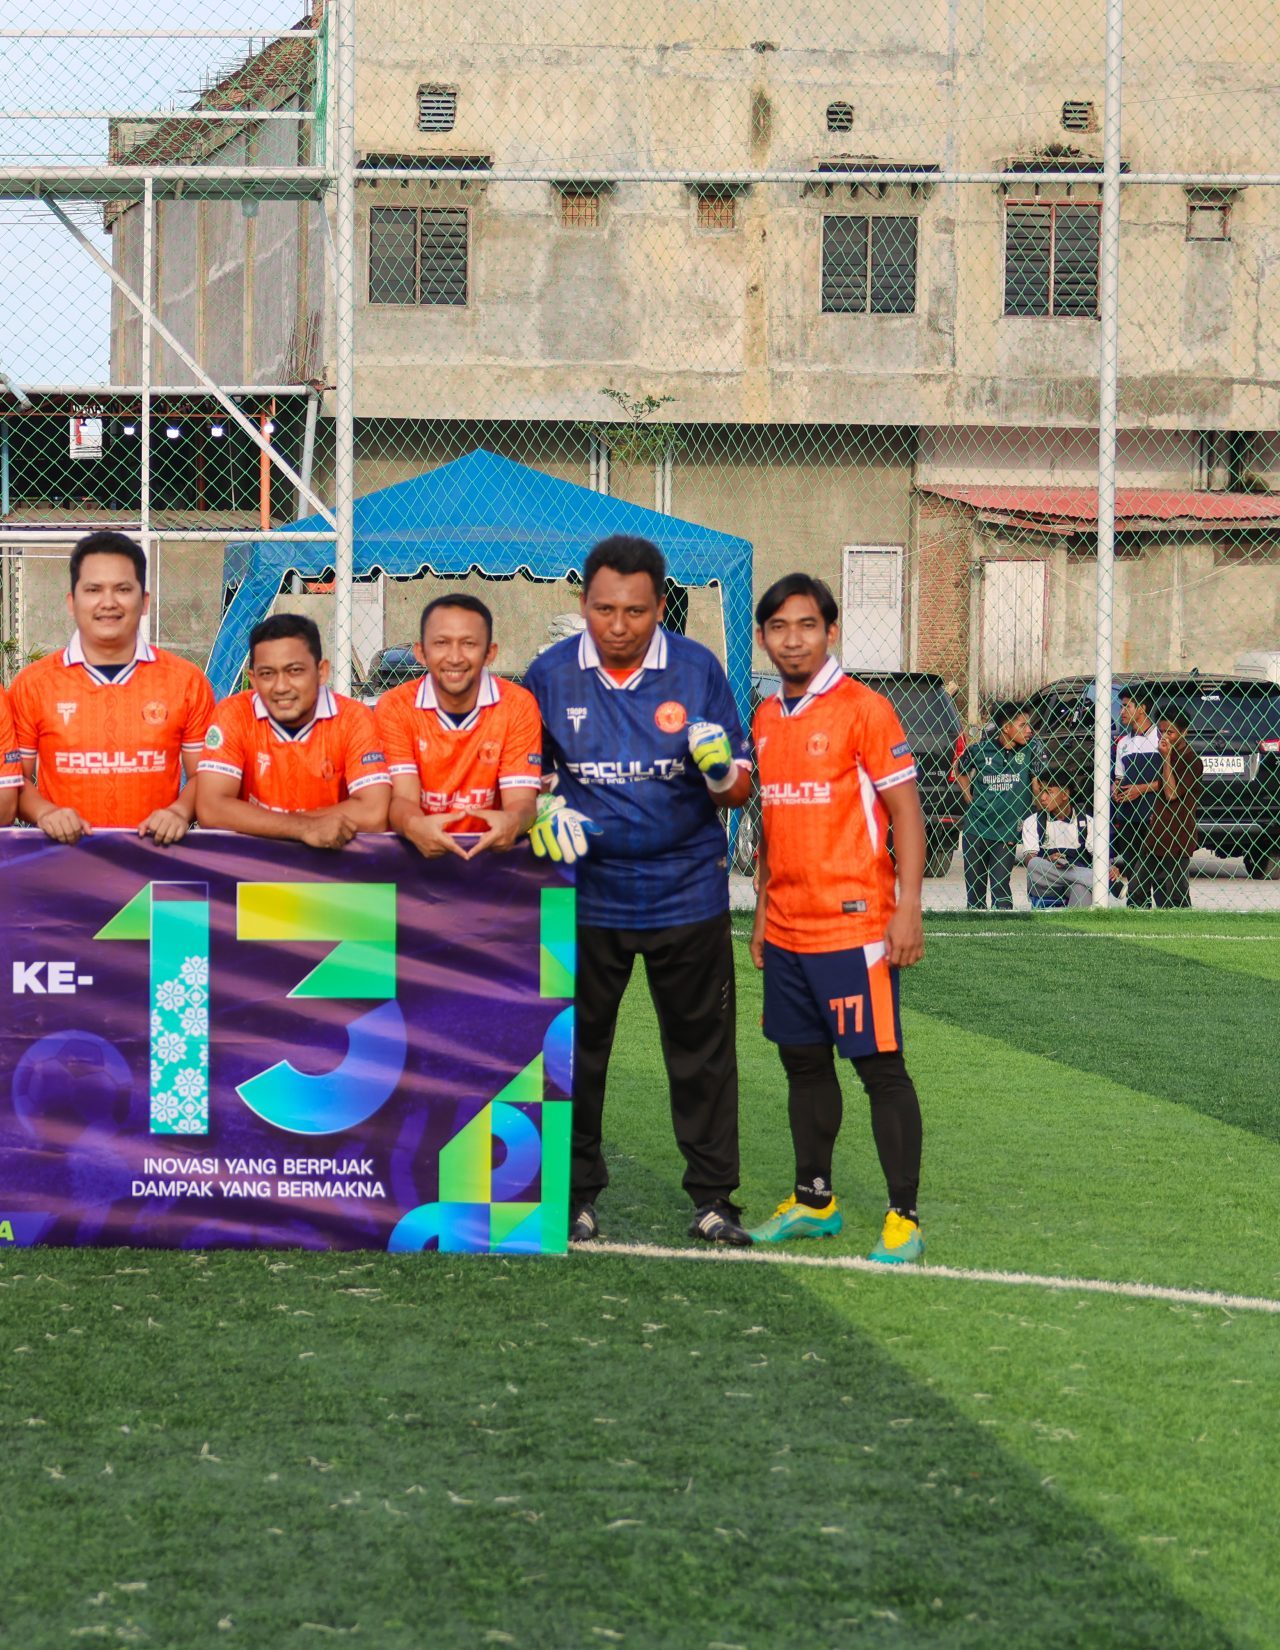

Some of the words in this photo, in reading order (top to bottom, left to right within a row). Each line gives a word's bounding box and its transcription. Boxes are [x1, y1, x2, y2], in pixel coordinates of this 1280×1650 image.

[55, 750, 167, 768] FACULTY
[566, 757, 686, 778] FACULTY
[12, 961, 94, 994] KE-
[93, 881, 408, 1136] 13
[829, 994, 864, 1036] 77
[144, 1158, 219, 1175] INOVASI
[225, 1158, 277, 1175] YANG
[283, 1159, 373, 1175] BERPIJAK
[131, 1181, 213, 1197] DAMPAK
[219, 1181, 271, 1198] YANG
[277, 1181, 386, 1198] BERMAKNA
